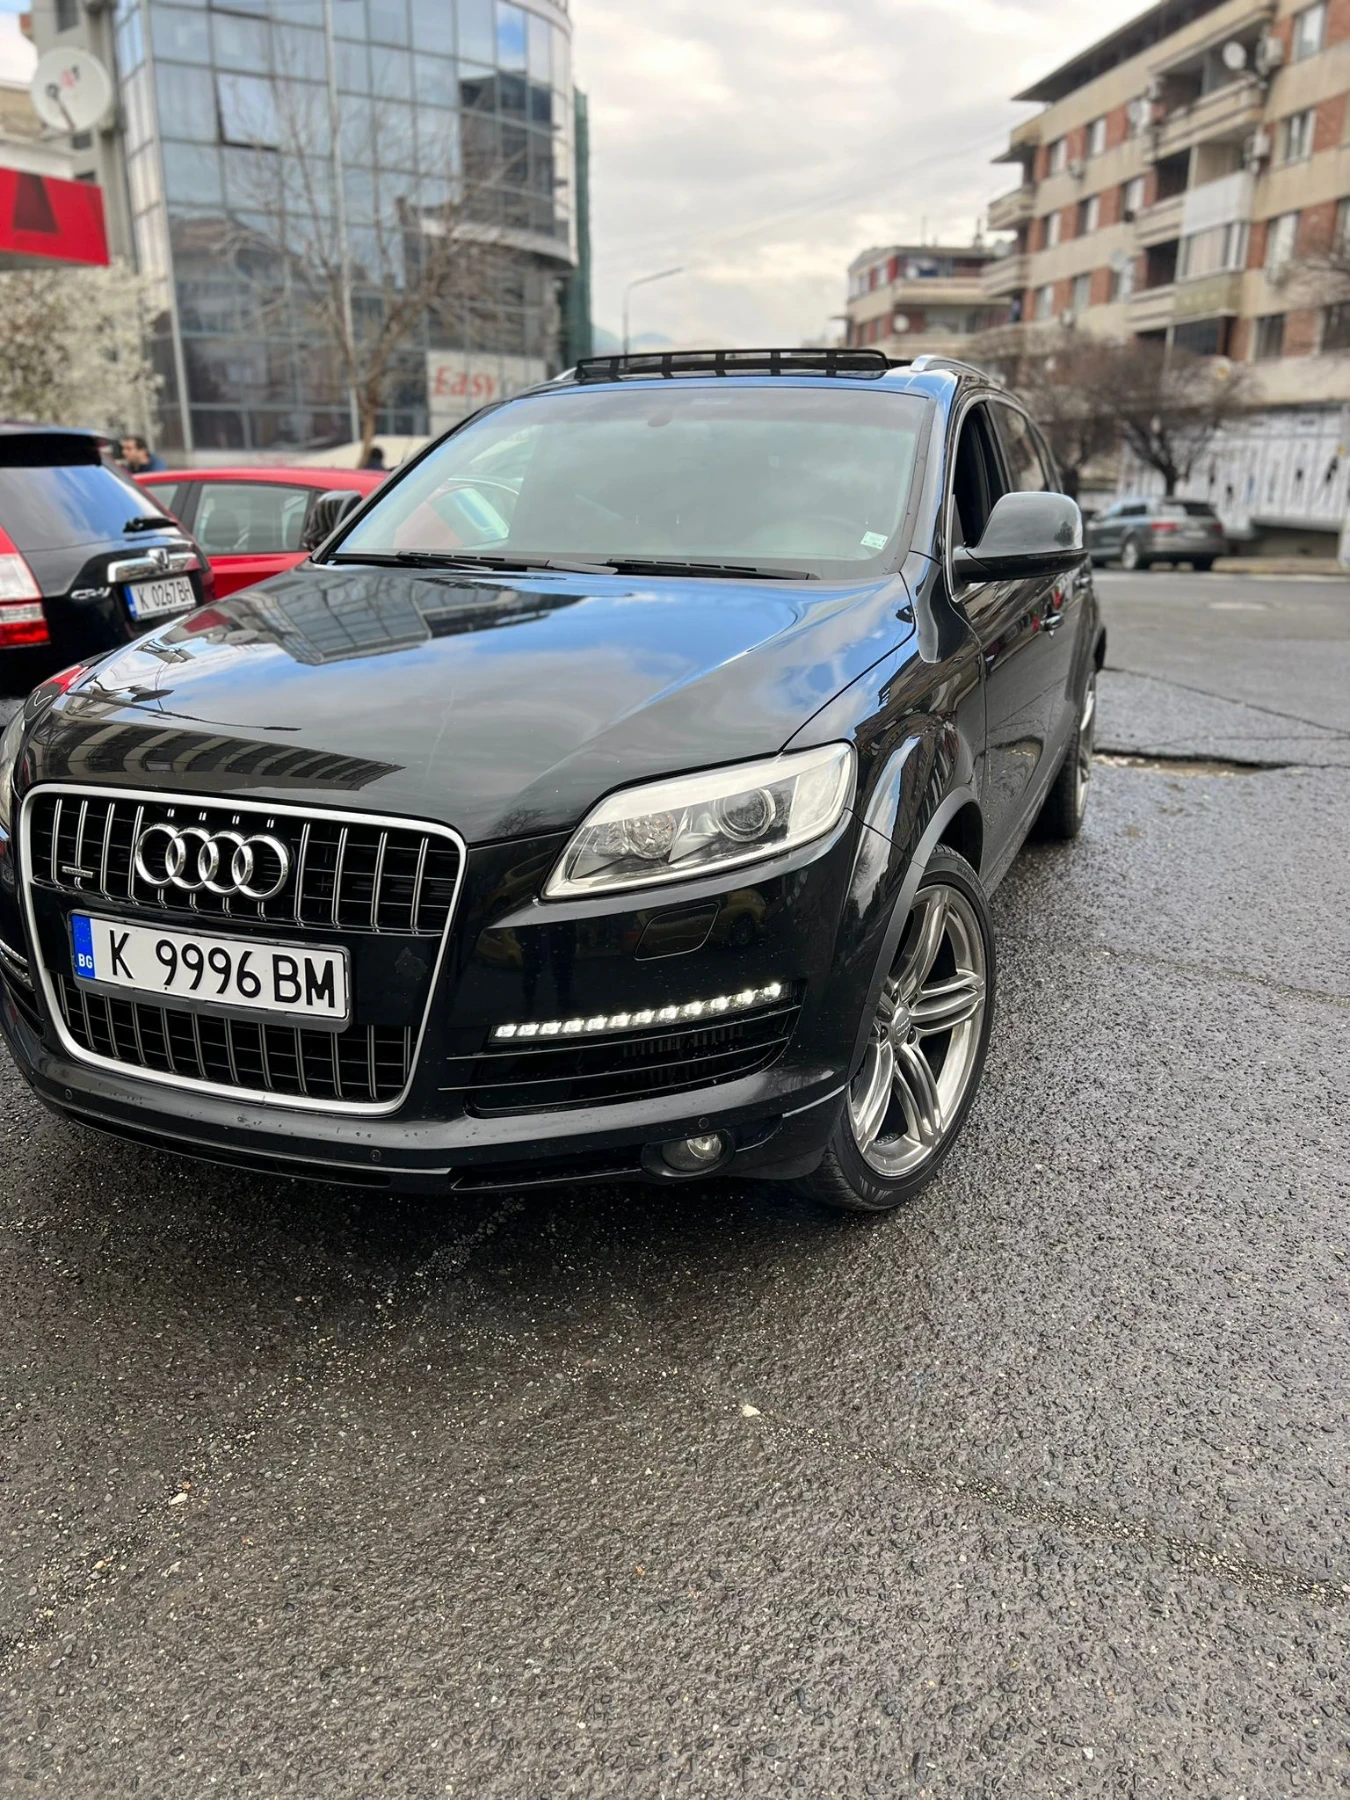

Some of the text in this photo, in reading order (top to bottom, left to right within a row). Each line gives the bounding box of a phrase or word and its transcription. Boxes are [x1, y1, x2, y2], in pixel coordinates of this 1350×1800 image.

[434, 366, 497, 403] Easy
[138, 587, 149, 610] K
[151, 582, 177, 606] 0267
[78, 953, 93, 968] BG
[109, 929, 335, 1008] K 9996 BM
